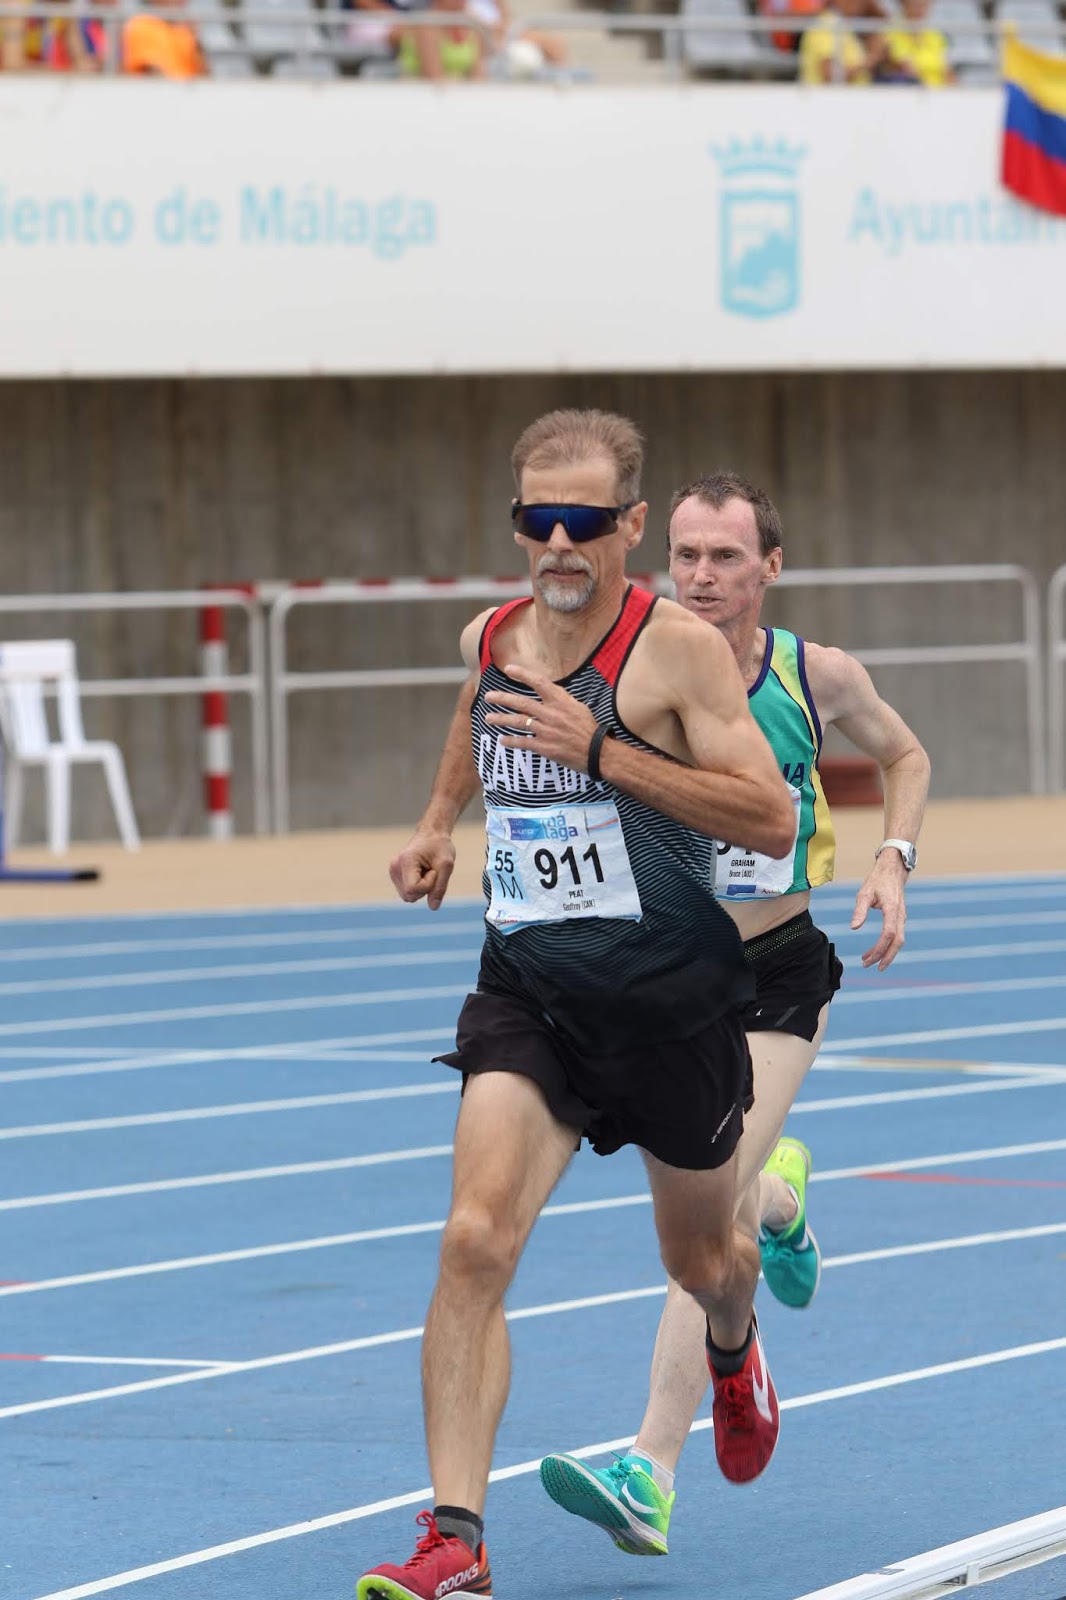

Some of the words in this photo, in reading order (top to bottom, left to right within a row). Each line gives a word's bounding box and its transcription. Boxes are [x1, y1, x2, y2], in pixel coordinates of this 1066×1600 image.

[154, 184, 221, 245] de
[240, 183, 437, 260] Málaga
[495, 849, 514, 873] 55
[534, 843, 604, 889] 911
[497, 873, 524, 900] M
[568, 890, 584, 898] PEAT
